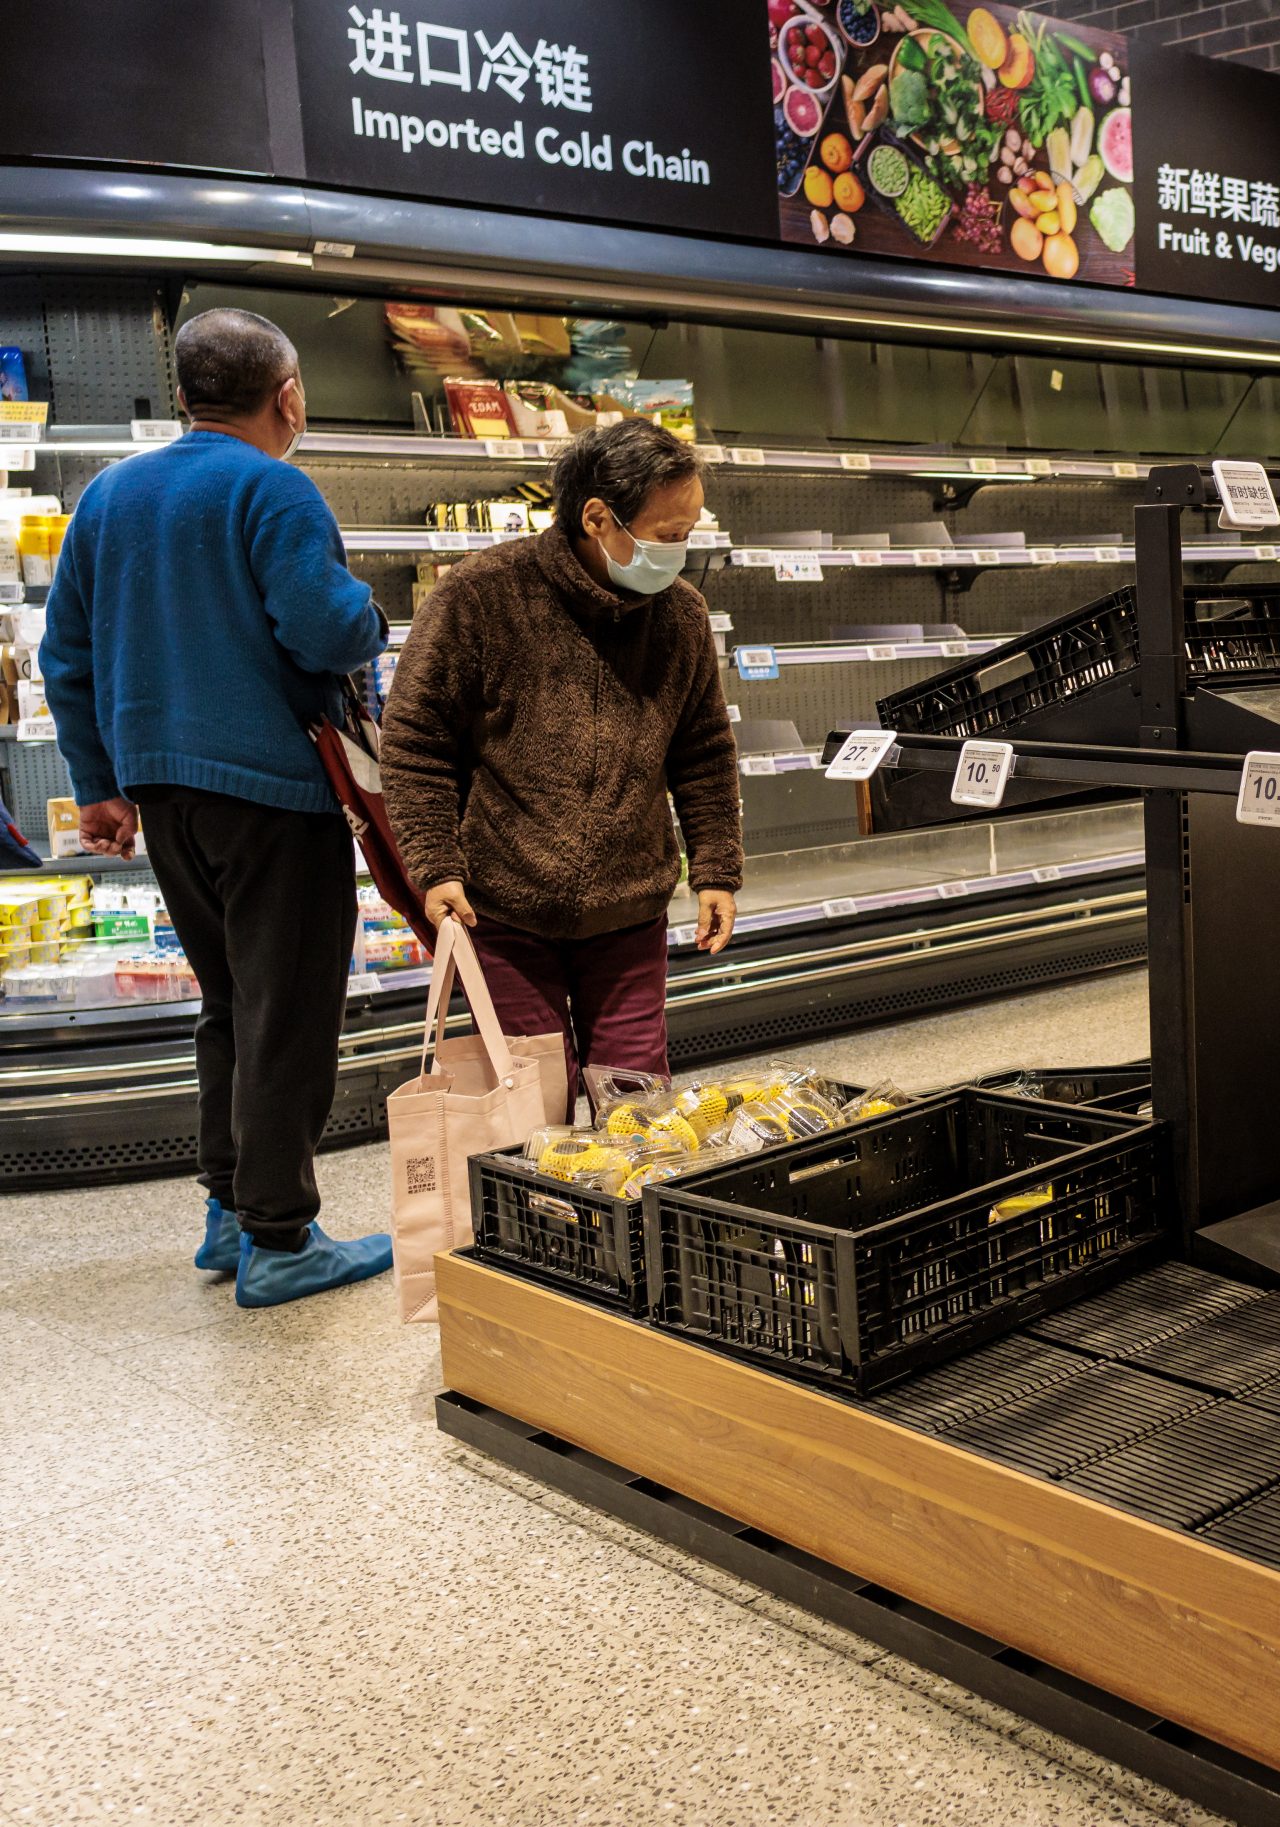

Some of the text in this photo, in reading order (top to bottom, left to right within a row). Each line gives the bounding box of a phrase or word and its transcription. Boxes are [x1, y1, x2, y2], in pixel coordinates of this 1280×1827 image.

[348, 4, 593, 113] 进口冷链
[352, 97, 711, 185] Imported Cold Chain
[1157, 163, 1280, 228] 新鲜果蔬
[1158, 223, 1211, 256] Fruit
[1214, 231, 1233, 259] &
[1226, 484, 1269, 500] 暂时缺货
[991, 763, 1001, 773] 50
